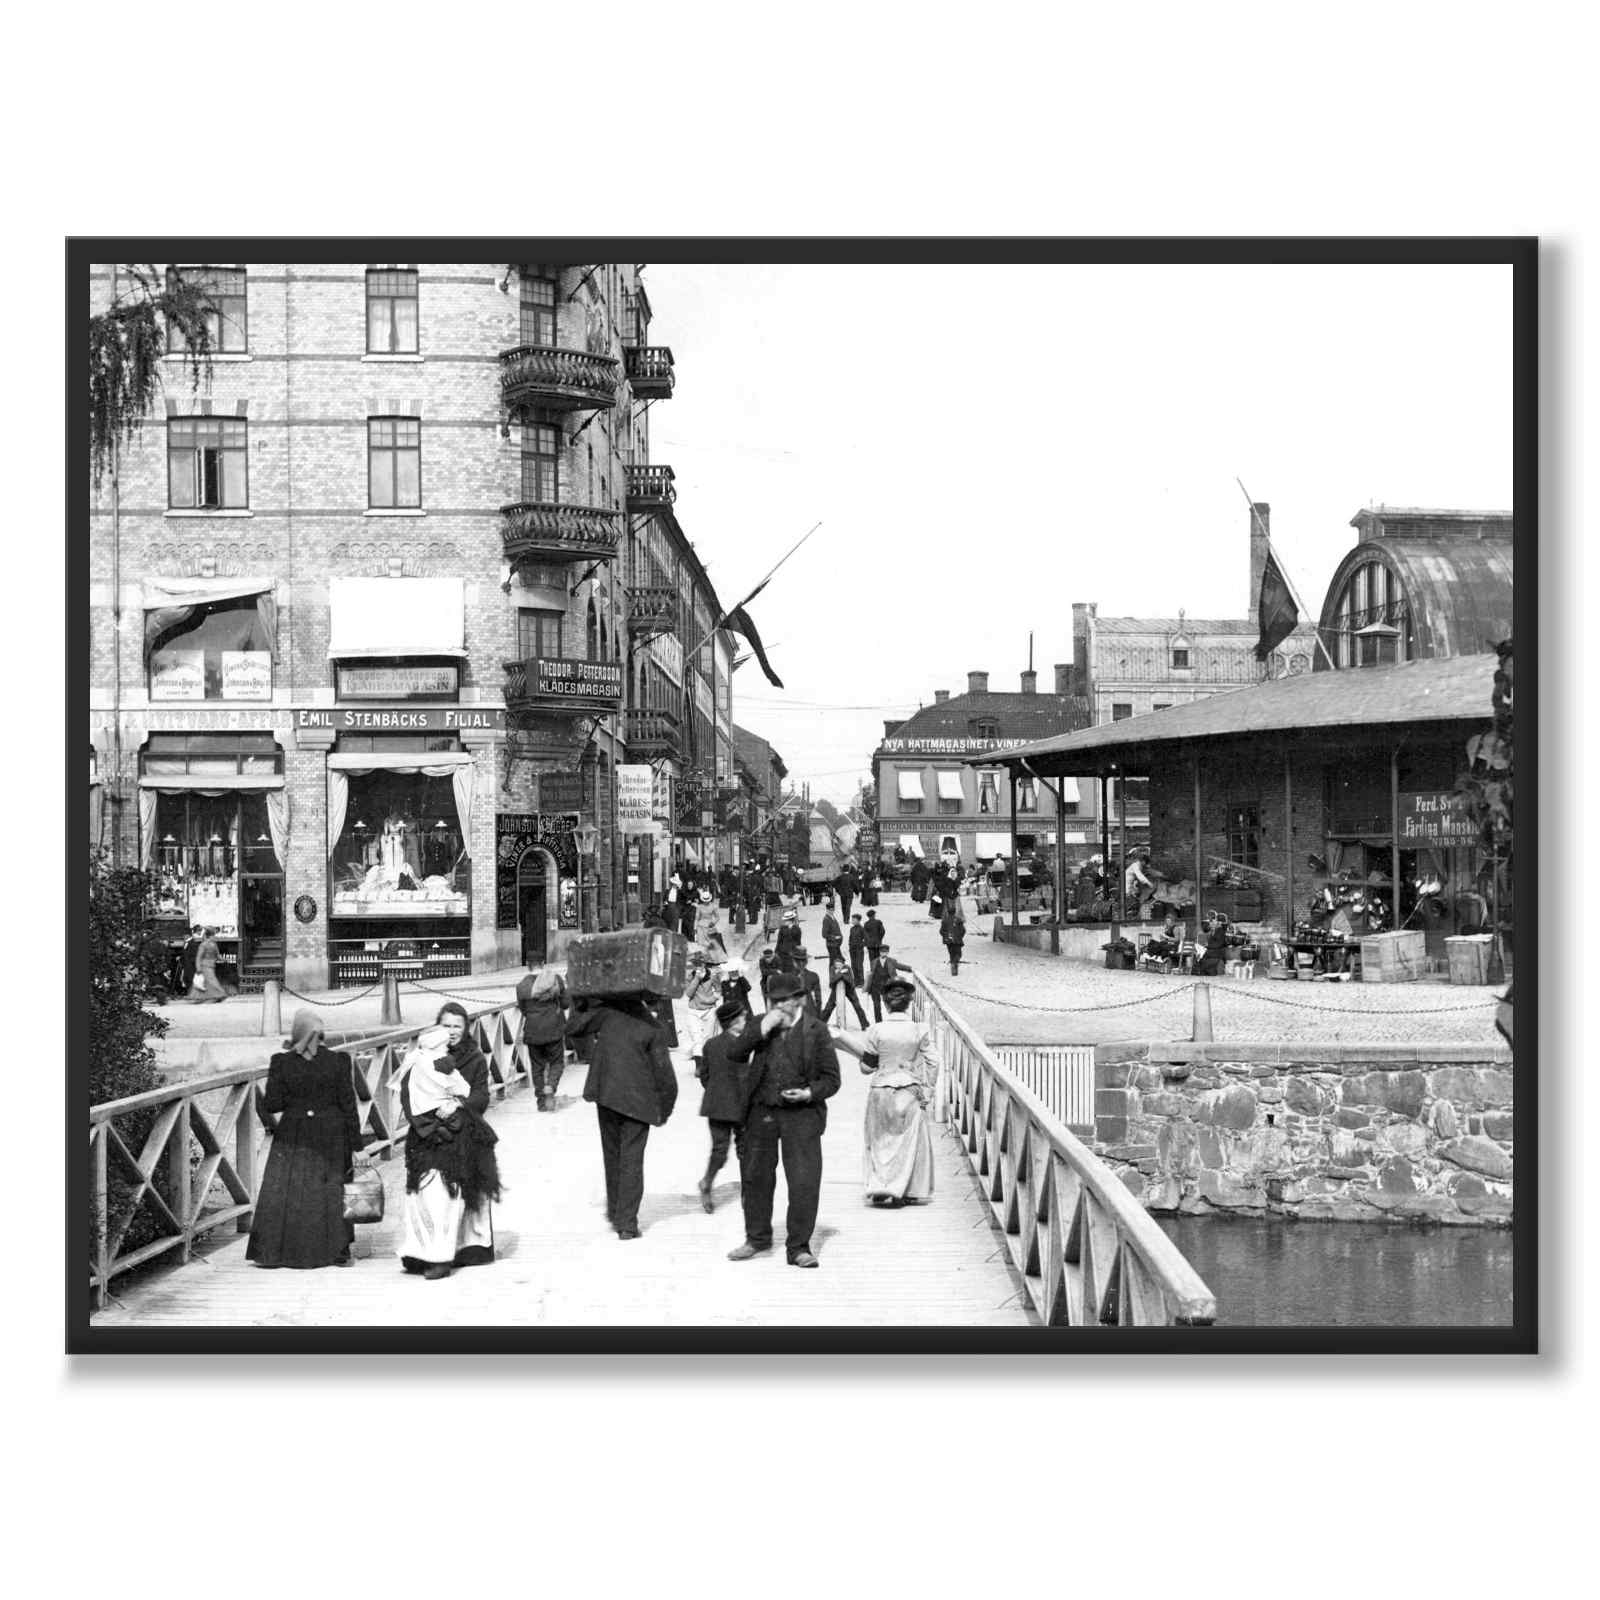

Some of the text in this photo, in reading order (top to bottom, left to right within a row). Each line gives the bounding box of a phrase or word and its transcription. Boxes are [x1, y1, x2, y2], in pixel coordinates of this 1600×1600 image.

[539, 679, 621, 697] KLÄDESMAGASIN
[299, 710, 491, 727] EMIL STENBÄCKS FILIAL
[884, 738, 904, 749] NYA
[907, 738, 989, 750] HATTMAGASINET
[619, 809, 651, 819] MAGASIN
[499, 815, 538, 833] JOHNSON
